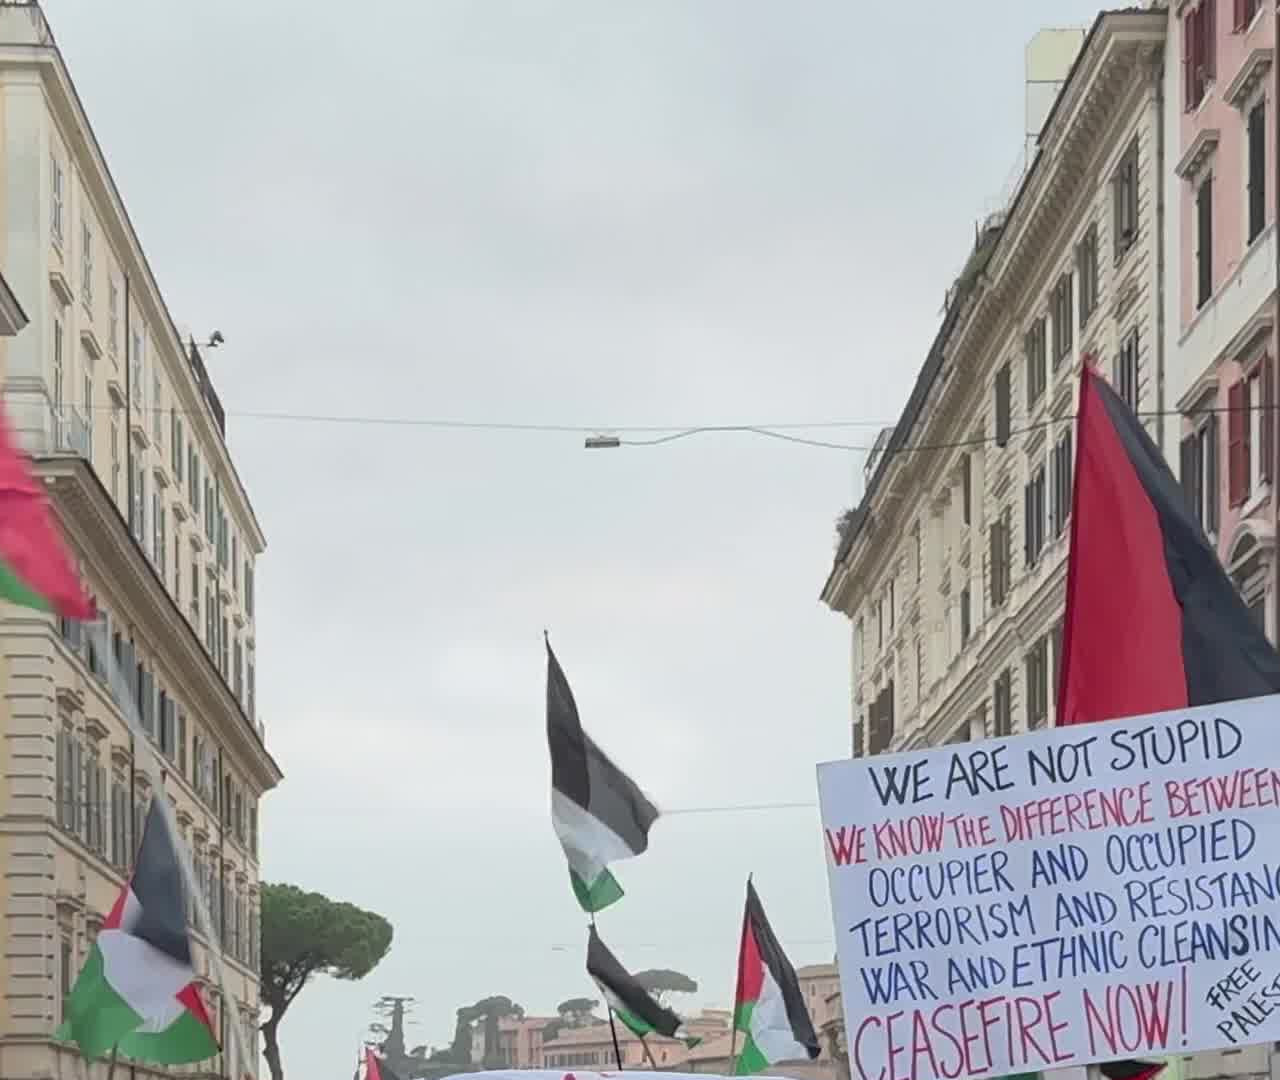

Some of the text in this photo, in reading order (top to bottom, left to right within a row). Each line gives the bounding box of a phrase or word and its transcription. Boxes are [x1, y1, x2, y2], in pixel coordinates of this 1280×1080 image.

[868, 717, 1243, 806] WE ARE NOT STUPID
[825, 824, 868, 866] WE
[872, 812, 945, 860] KNOW
[946, 814, 996, 848] THE
[1000, 781, 1155, 843] DIFFERENCE
[869, 818, 1256, 908] OCCUPIER AND OCCUPIED
[849, 894, 1037, 957] TERRORISM
[1055, 890, 1118, 932] AND
[860, 960, 939, 1005] WAR
[947, 955, 1007, 995] AND
[1012, 930, 1128, 989] ETHNIC
[1205, 958, 1262, 1011] FREE
[1083, 965, 1189, 1056] NOW!
